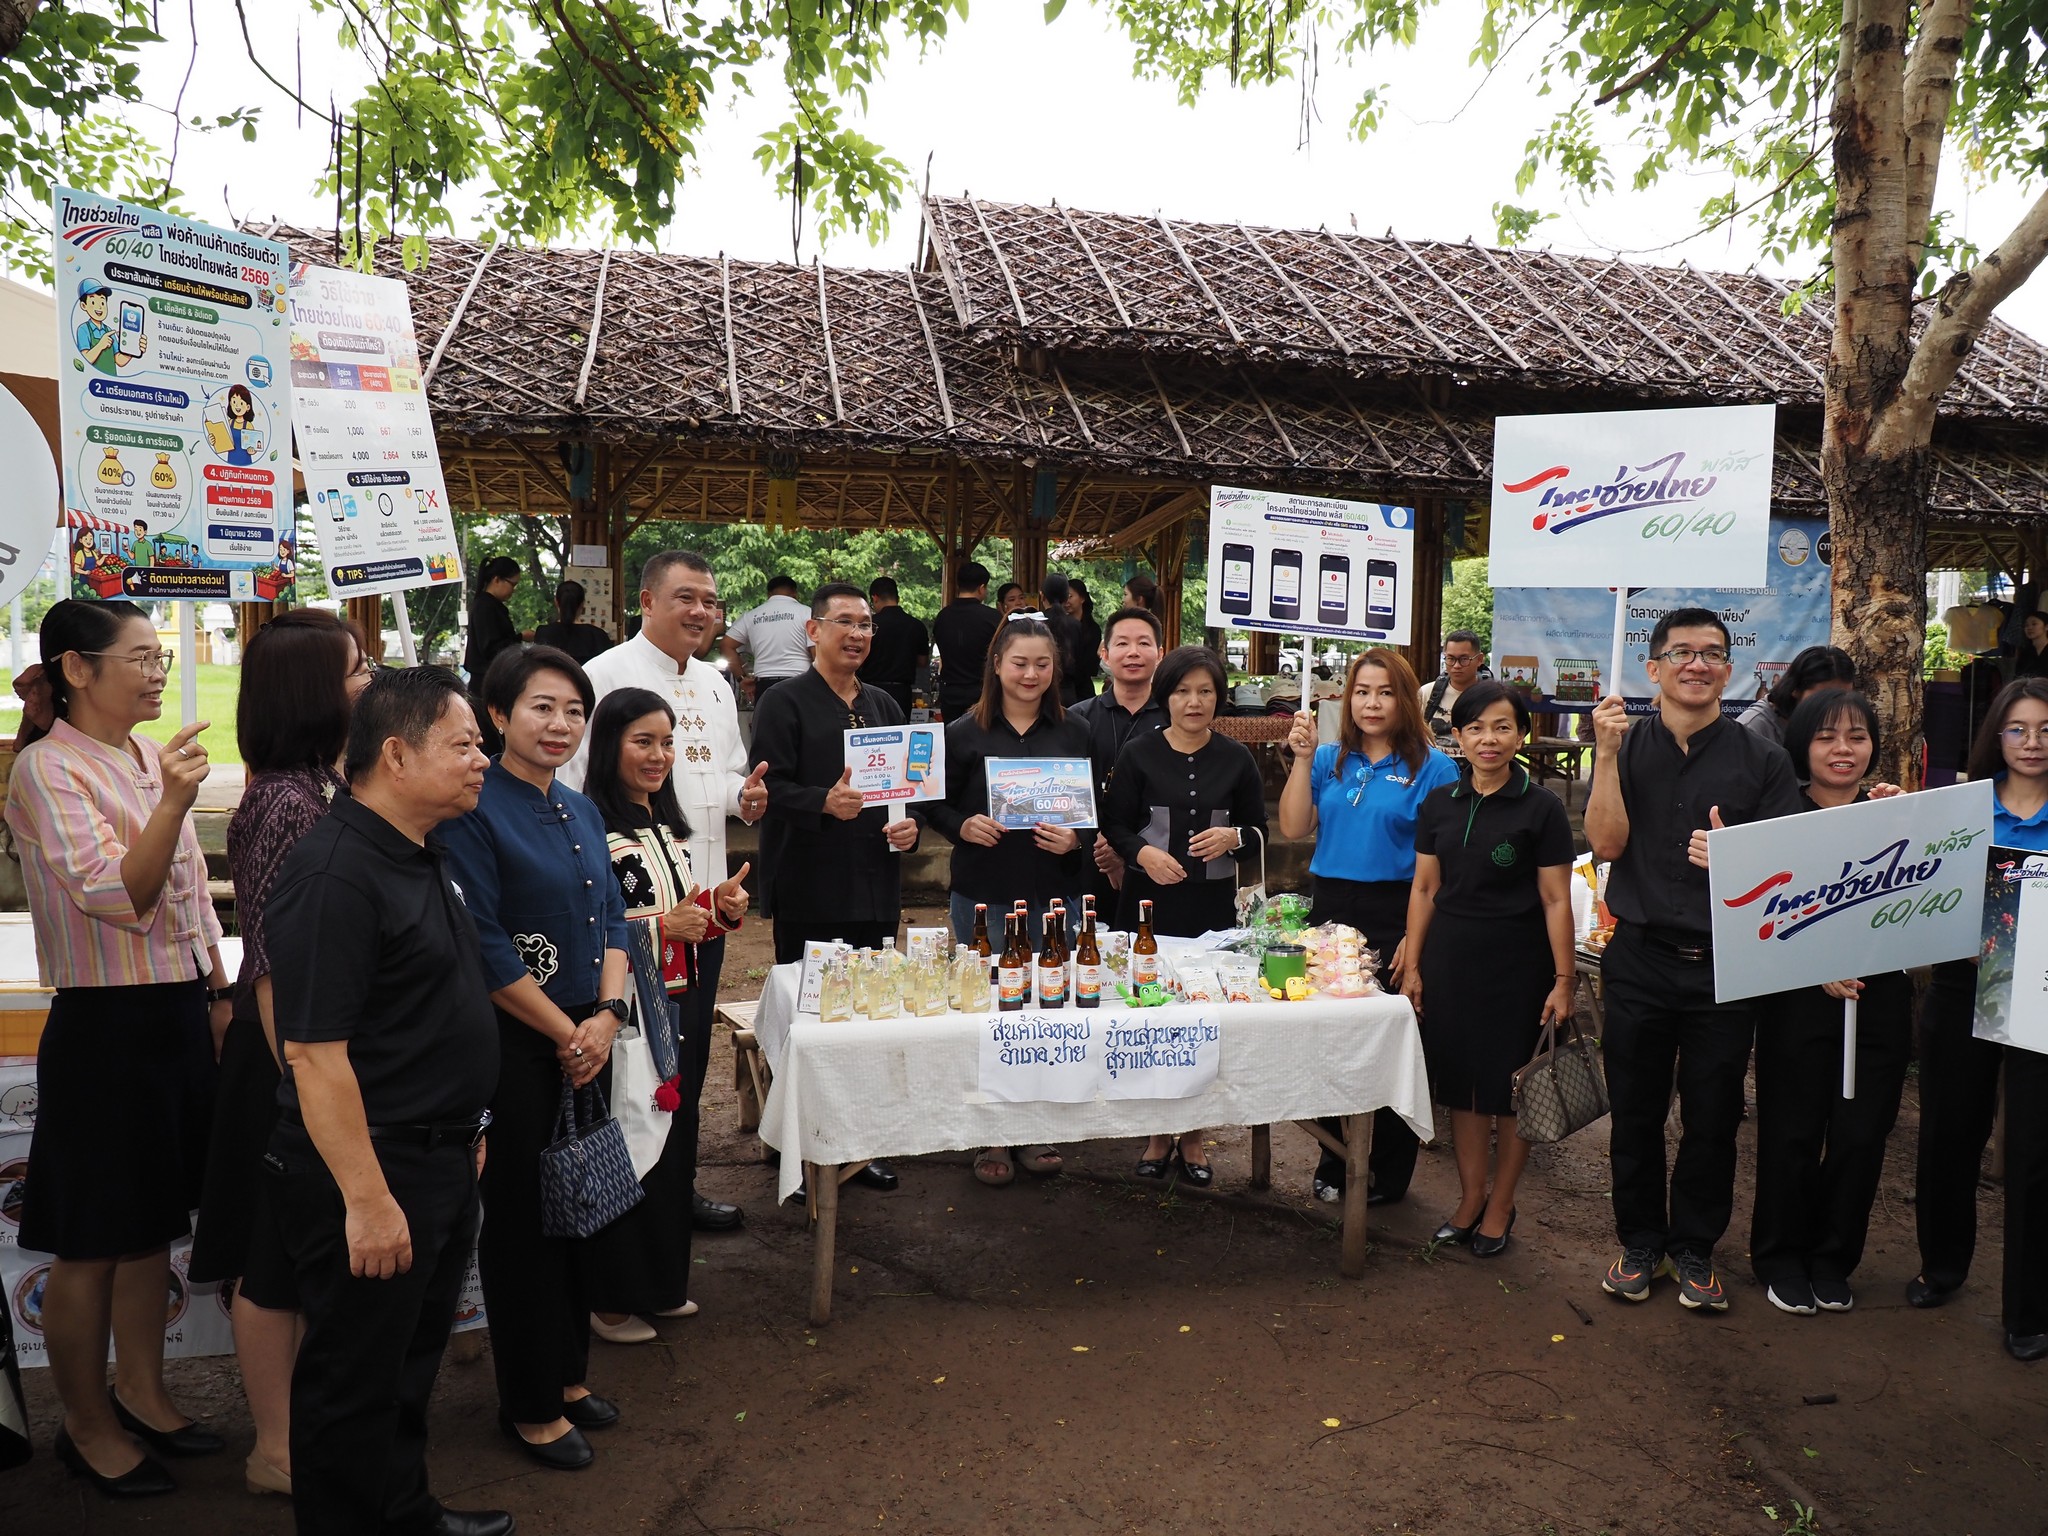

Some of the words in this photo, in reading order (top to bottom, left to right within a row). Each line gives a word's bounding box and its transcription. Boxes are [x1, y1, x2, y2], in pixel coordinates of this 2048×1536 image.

[62, 198, 140, 227] ไทยช่วยไทย
[142, 225, 161, 238] พลัส
[105, 237, 153, 260] 60/40
[167, 223, 280, 266] พ่อค้าแม่ค้าเตรียมตัว!
[159, 244, 238, 279] ไทยช่วยไทยพลัส
[241, 266, 270, 286] 2569
[111, 269, 162, 287] ประชาสัมพันธ์:
[156, 302, 163, 311] 1.
[365, 314, 401, 333] 60:40
[95, 382, 104, 394] 2.
[106, 385, 153, 400] เตรียมเอกสาร
[155, 388, 185, 406] (ร้านใหม่)
[344, 400, 356, 409] 200
[404, 403, 415, 411] 333
[347, 427, 364, 436] 1,000
[380, 427, 391, 436] 667
[93, 430, 102, 440] 3.
[138, 436, 144, 444] &
[145, 436, 178, 448] การรับเงิน
[352, 451, 370, 460] 4,000
[382, 451, 399, 460] 2,664
[412, 451, 428, 460] 6,664
[102, 468, 121, 478] 40%
[154, 472, 172, 482] 60%
[210, 468, 218, 477] 4.
[1502, 451, 1718, 532] ไทยช่วยไทย
[1700, 450, 1764, 473] พลัส
[246, 497, 262, 505] 2569
[1289, 496, 1348, 510] สถานะการลงทะเบียน
[1329, 510, 1343, 519] พลัส
[1344, 512, 1368, 523] (60/40)
[1642, 507, 1736, 544] 60/40
[247, 530, 262, 538] 2569
[149, 572, 225, 585] ติดตามข่าวสารด่วน!
[1638, 654, 1645, 662] @
[863, 735, 899, 744] เริ่มลงทะเบียน
[867, 754, 886, 767] 25
[1722, 838, 1942, 941] ไทยช่วยไทย
[1924, 827, 1986, 856] พลัส
[1870, 887, 1963, 928] 60/40
[988, 1014, 1091, 1042] สินค้าโอทอป
